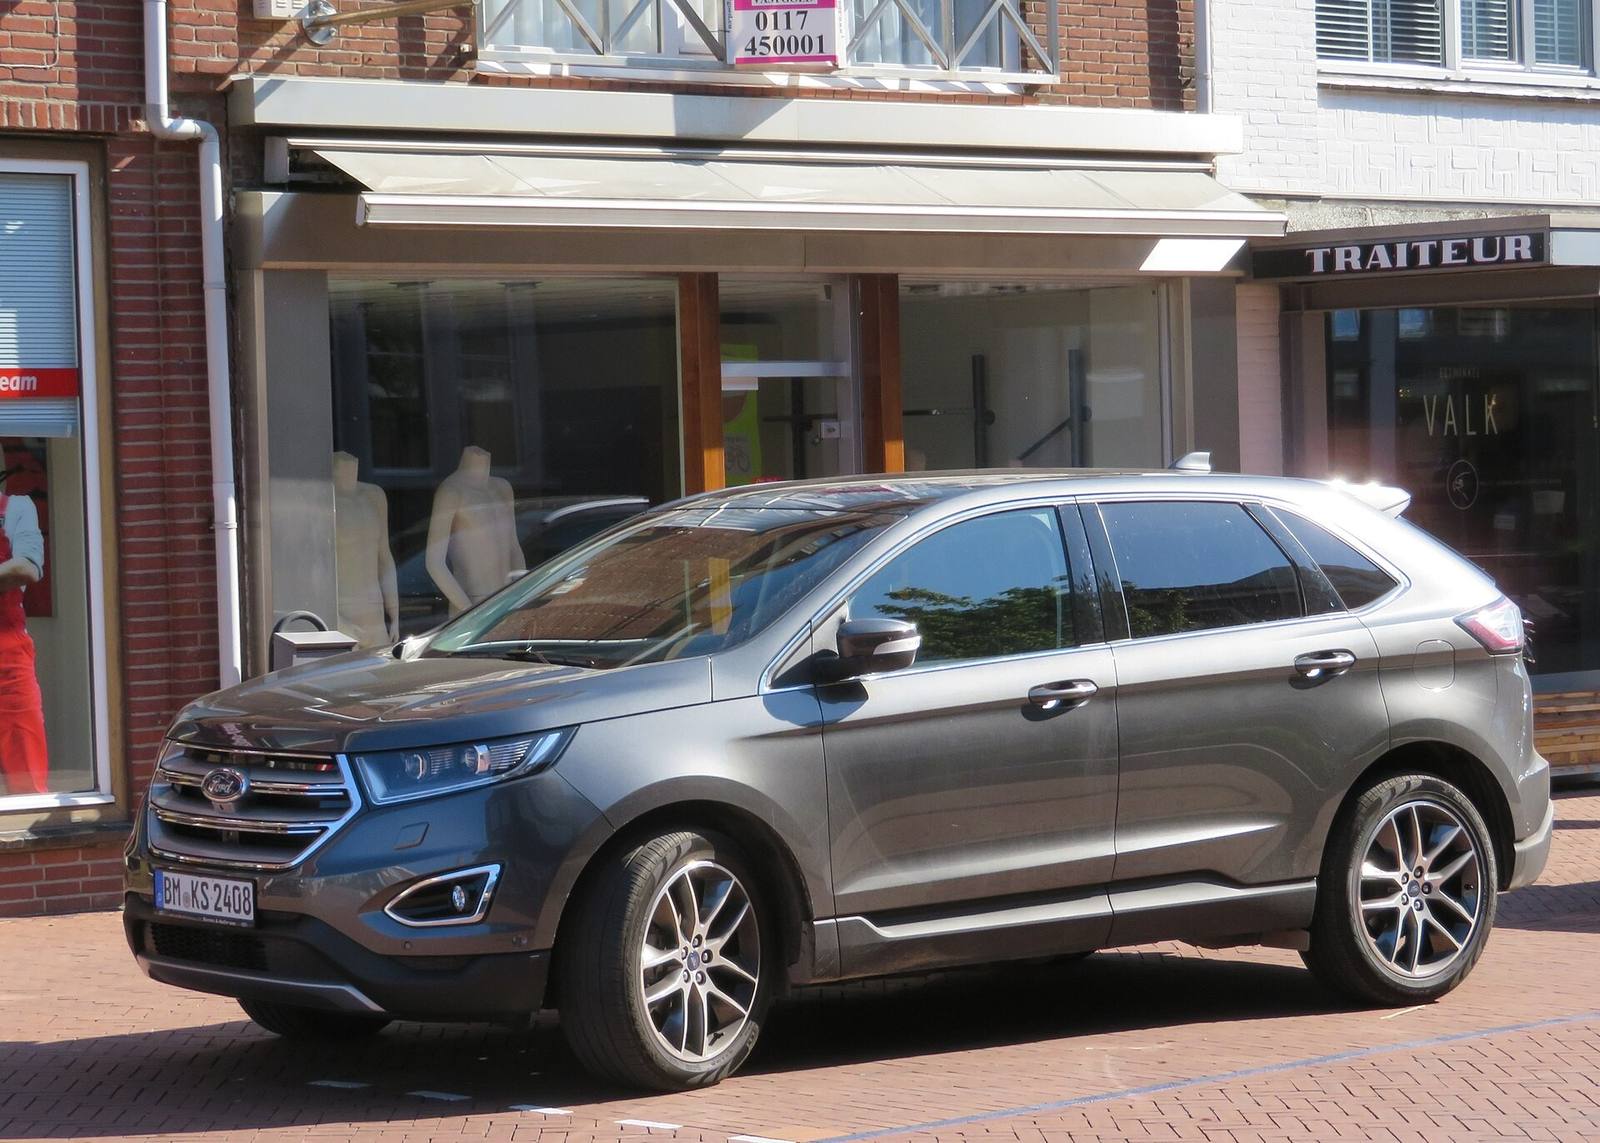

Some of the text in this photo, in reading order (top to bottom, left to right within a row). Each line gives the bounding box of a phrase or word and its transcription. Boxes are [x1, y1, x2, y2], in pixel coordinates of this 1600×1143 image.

[755, 10, 808, 31] 0117
[744, 34, 825, 55] 450001
[1305, 235, 1532, 273] TRAITEUR
[1423, 394, 1498, 436] VALK
[208, 776, 234, 794] Ford
[164, 876, 251, 915] BM KS 2408
